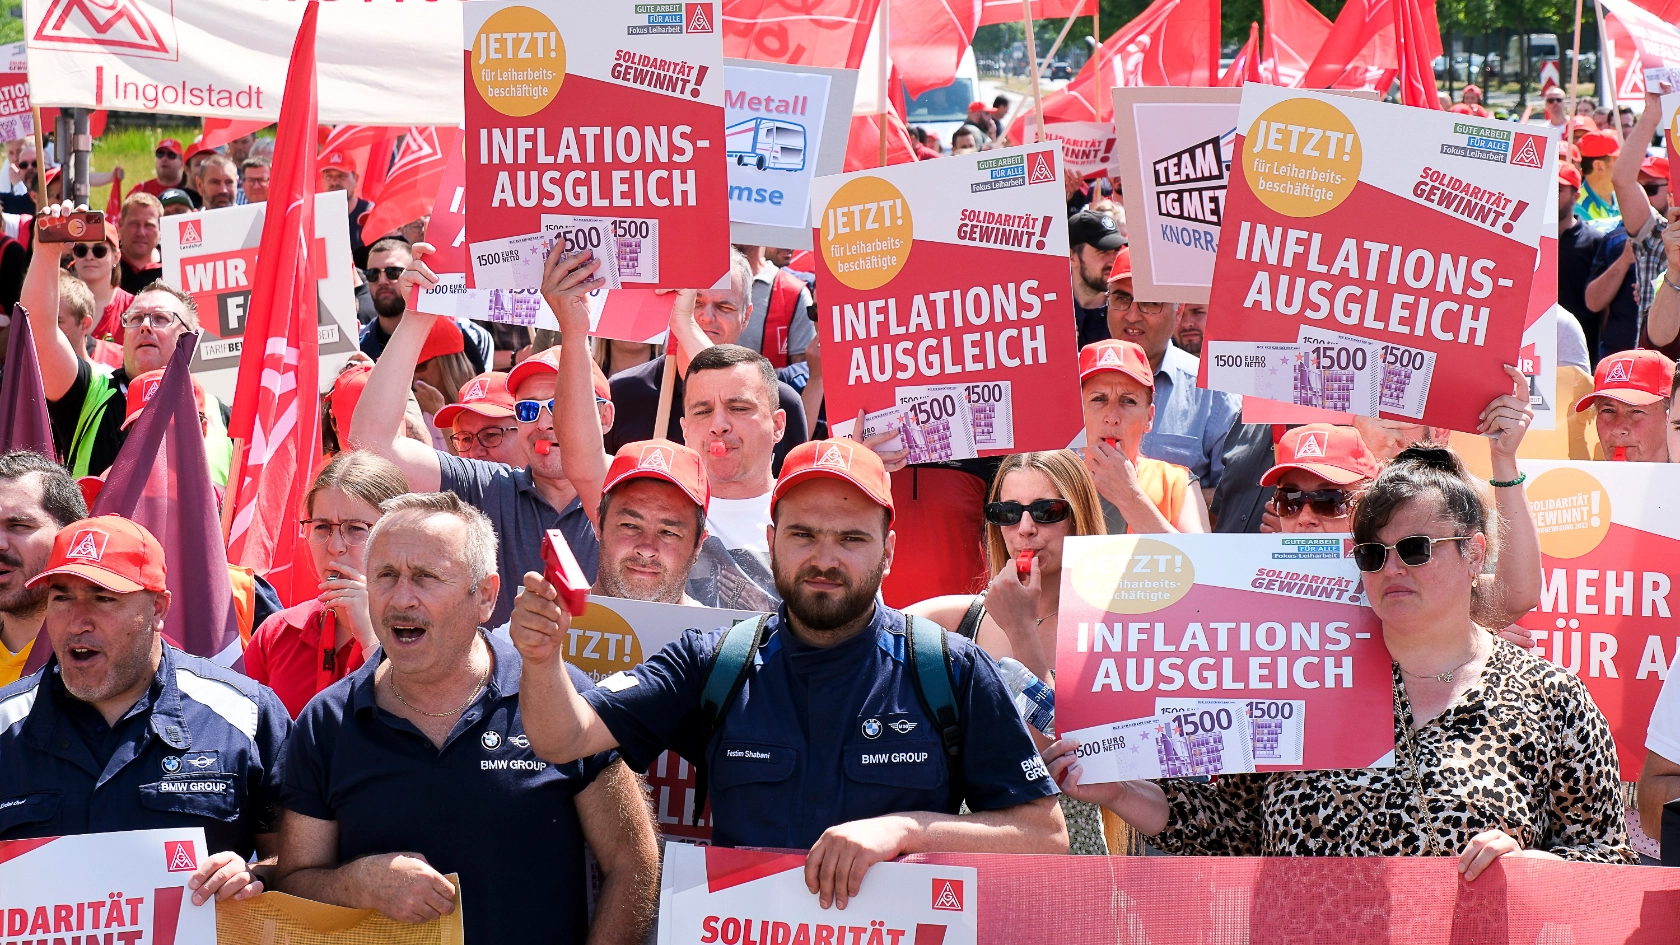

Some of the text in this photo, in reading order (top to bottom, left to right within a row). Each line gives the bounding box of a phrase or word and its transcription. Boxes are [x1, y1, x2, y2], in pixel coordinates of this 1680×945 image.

[637, 4, 682, 13] GUTE ARBEIT
[650, 14, 681, 23] FÜR ALLE
[629, 26, 648, 34] Fokus
[478, 31, 557, 65] JETZT!
[481, 67, 557, 81] für Leiharbeits-
[613, 48, 695, 78] SOLIDARITÄT
[114, 74, 264, 110] Ingolstadt
[488, 83, 549, 100] beschäftigte
[724, 89, 808, 116] Metall
[479, 124, 711, 165] INFLATIONS-
[1252, 119, 1354, 162] JETZT!
[1456, 125, 1508, 140] GUTE ARBEIT
[1469, 137, 1507, 151] FÜR ALLE
[979, 156, 1022, 169] GUTE ARBEIT
[1155, 142, 1220, 184] TEAM
[1443, 146, 1505, 162] Fokus Leiharbeit
[992, 167, 1023, 178] FÜR ALLE
[1253, 158, 1347, 185] für Leiharbeits-
[490, 169, 698, 209] AUSGLEICH
[972, 183, 991, 192] Fokus
[1258, 176, 1334, 203] beschäftigte
[1419, 166, 1513, 212] SOLIDARITÄT
[1160, 192, 1180, 216] IG
[611, 219, 650, 239] 1500
[827, 198, 903, 241] JETZT!
[960, 208, 1039, 230] SOLIDARITÄT
[476, 249, 519, 267] 1500 EURO
[830, 238, 904, 258] für Leiharbeits-
[1235, 220, 1515, 300] INFLATIONS-
[185, 257, 249, 294] WIR
[837, 255, 897, 273] beschäftigte
[831, 279, 1058, 343] INFLATIONS-
[1243, 270, 1491, 347] AUSGLEICH
[848, 324, 1047, 386] AUSGLEICH
[1214, 354, 1243, 368] 1500
[1311, 346, 1367, 371] 1500
[1381, 345, 1425, 371] 1500
[964, 383, 1003, 404] 1500
[910, 394, 957, 426] 1500
[1256, 567, 1354, 588] SOLIDARITÄT
[1529, 567, 1672, 618] MEHR
[566, 628, 633, 663] TZT!
[1077, 620, 1372, 653] INFLATIONS-
[1090, 656, 1354, 692] AUSGLEICH
[1172, 707, 1233, 737] 1500
[1246, 701, 1293, 719] 1500
[1102, 735, 1125, 747] EURO
[1103, 742, 1126, 753] NETTO
[480, 760, 547, 771] BMW GROUP
[861, 752, 928, 764] BMW GROUP
[161, 782, 227, 792] BMW GROUP
[700, 915, 906, 945] SOLIDARITÄT
